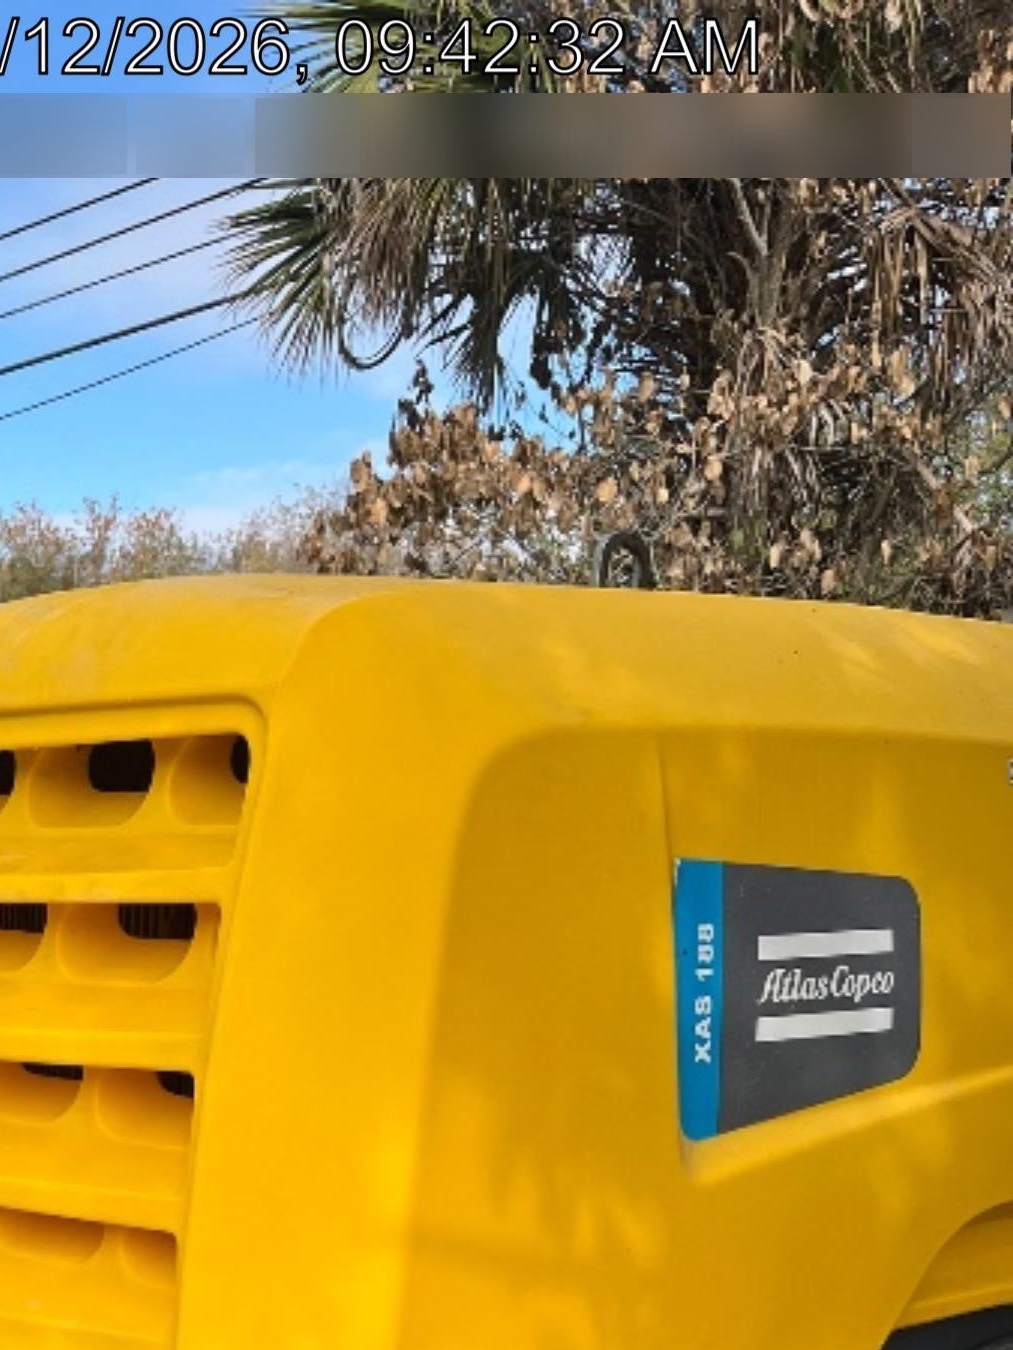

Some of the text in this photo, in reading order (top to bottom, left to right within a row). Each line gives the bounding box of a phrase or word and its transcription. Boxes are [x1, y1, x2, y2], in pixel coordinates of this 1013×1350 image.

[694, 922, 715, 1064] XAS 188
[757, 964, 895, 1005] Atlas Copco
